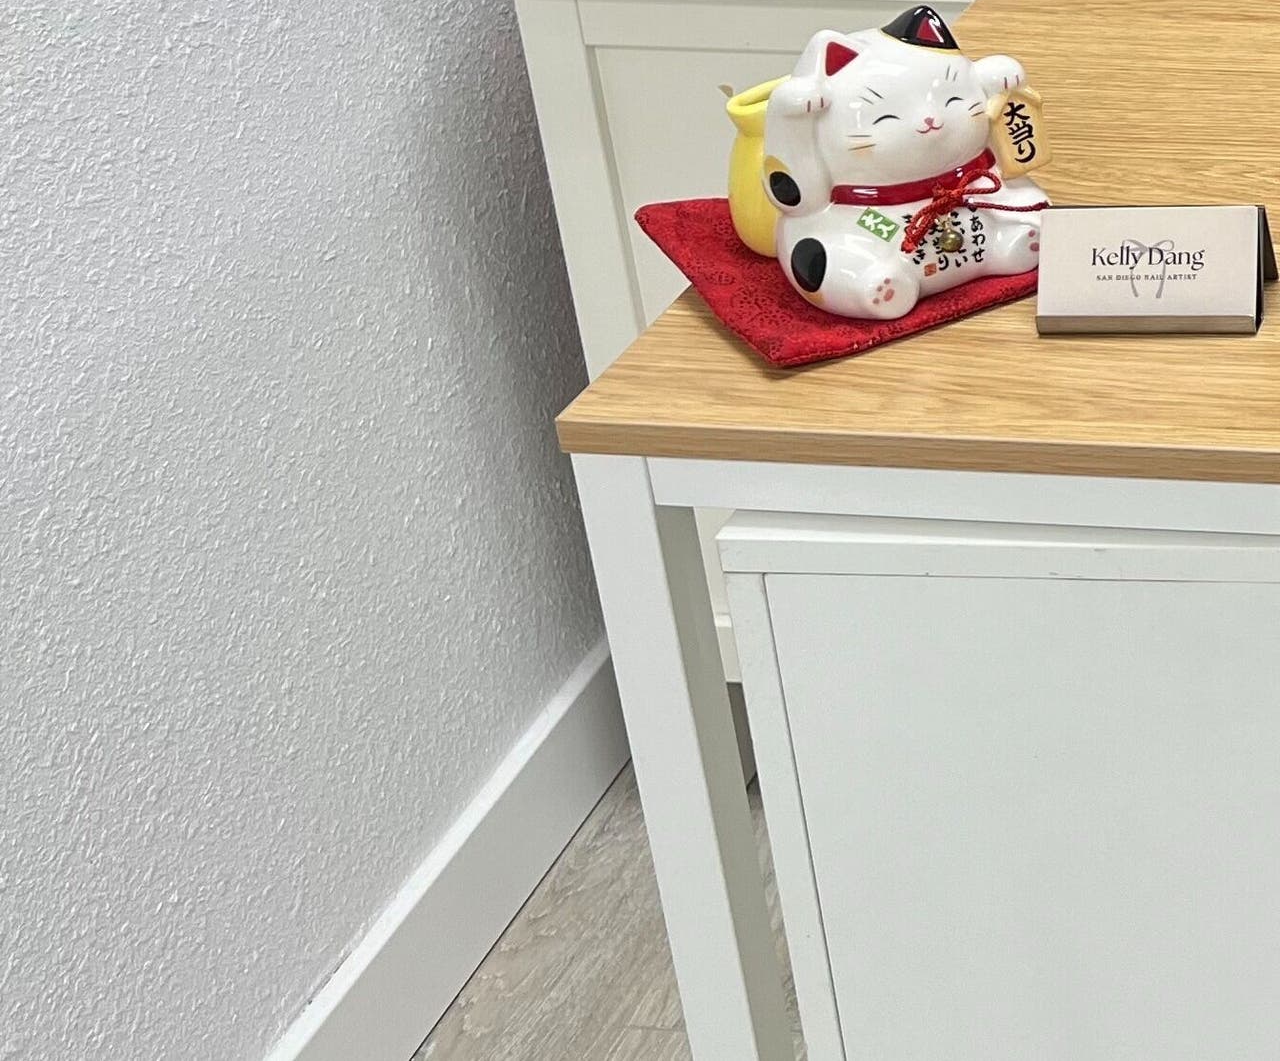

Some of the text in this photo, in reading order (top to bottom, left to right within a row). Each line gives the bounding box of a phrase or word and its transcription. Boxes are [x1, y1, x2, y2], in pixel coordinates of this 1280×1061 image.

[1003, 102, 1036, 163] 大当り
[1091, 245, 1206, 271] Kelly Dang
